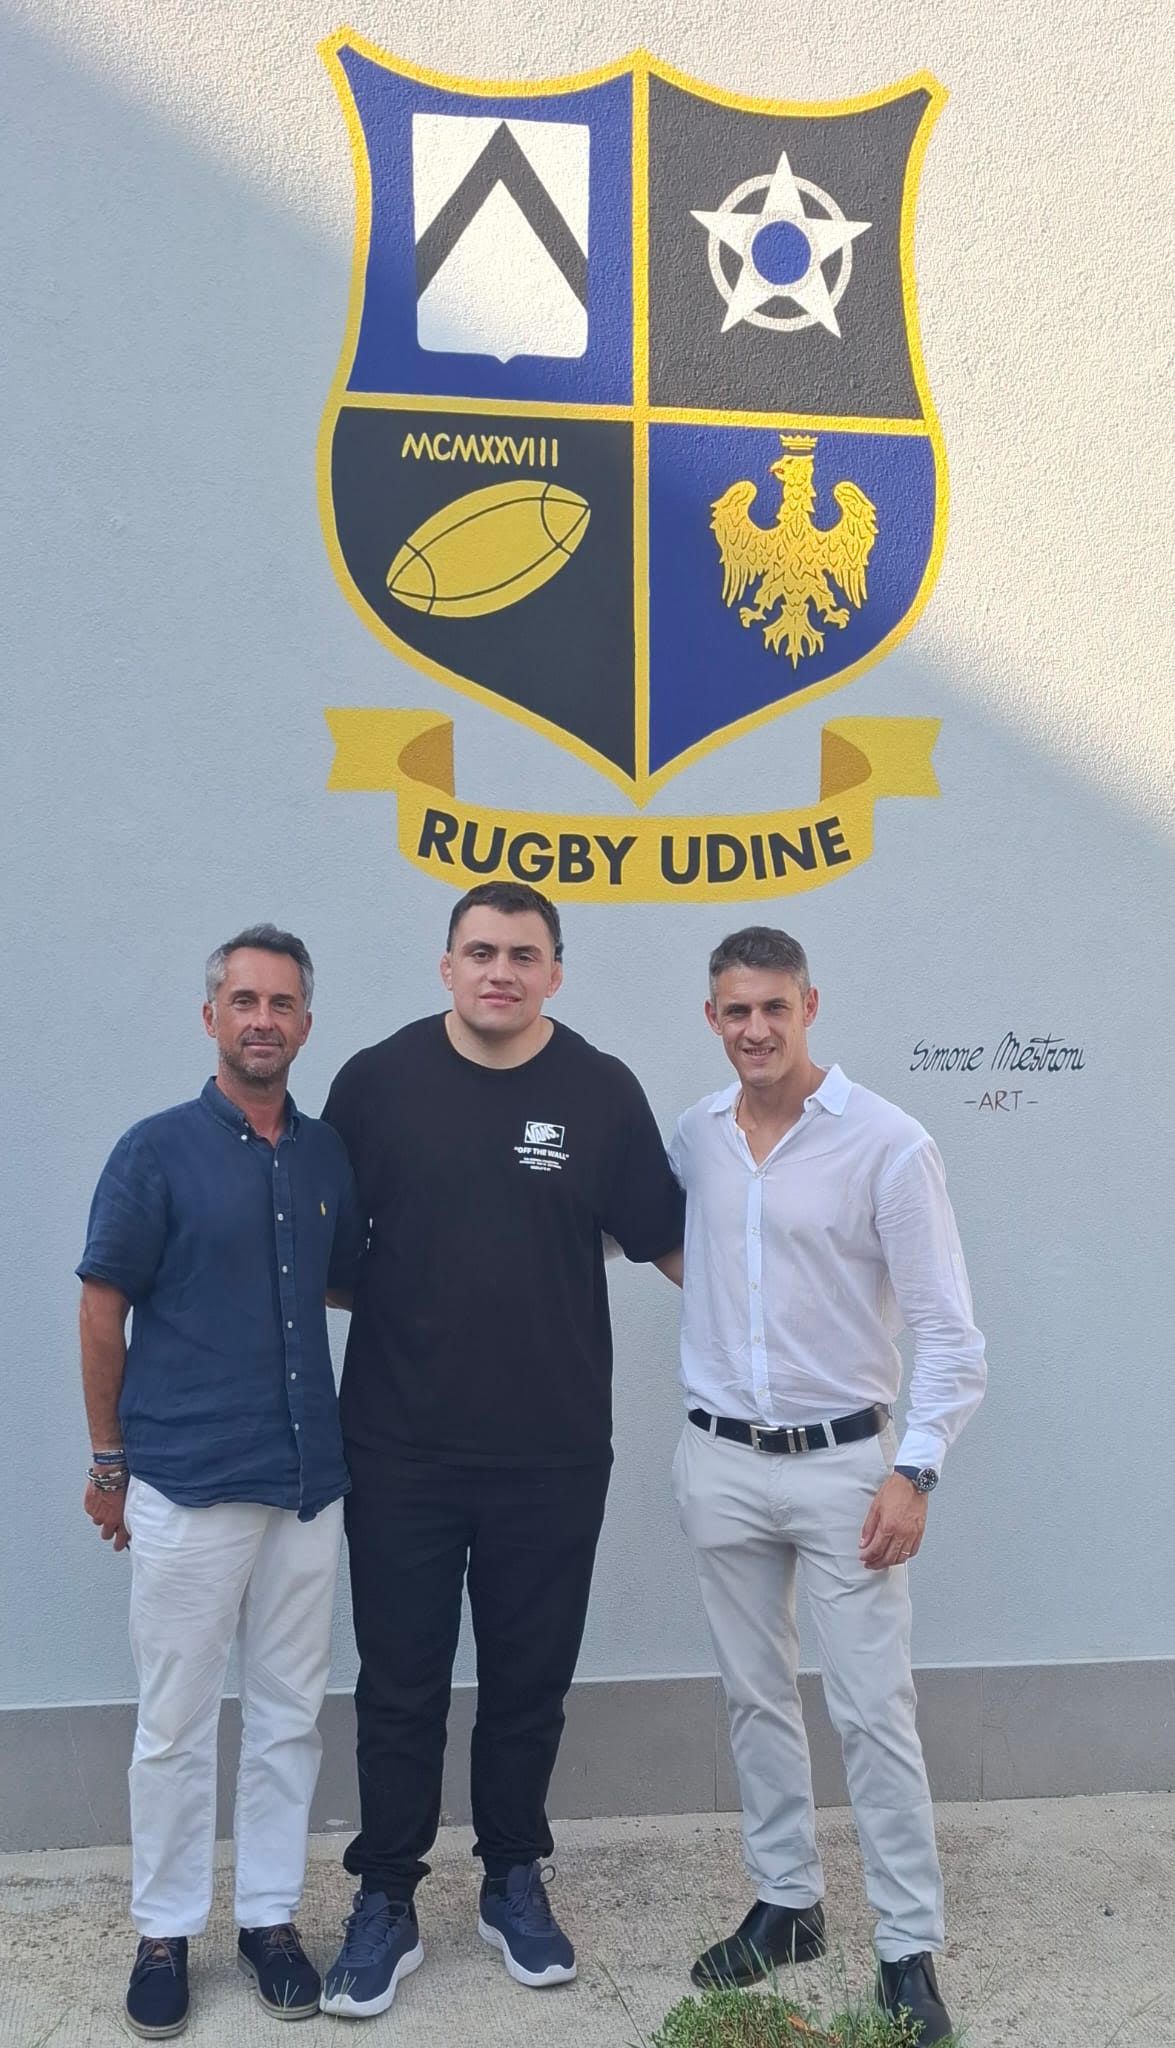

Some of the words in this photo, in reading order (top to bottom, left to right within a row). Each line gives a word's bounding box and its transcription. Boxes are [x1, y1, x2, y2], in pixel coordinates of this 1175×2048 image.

[402, 432, 558, 467] MCMXXVIII
[417, 808, 637, 885] RUGBY
[661, 816, 851, 885] UDINE
[910, 1039, 984, 1071] Simone
[533, 1147, 547, 1156] THE
